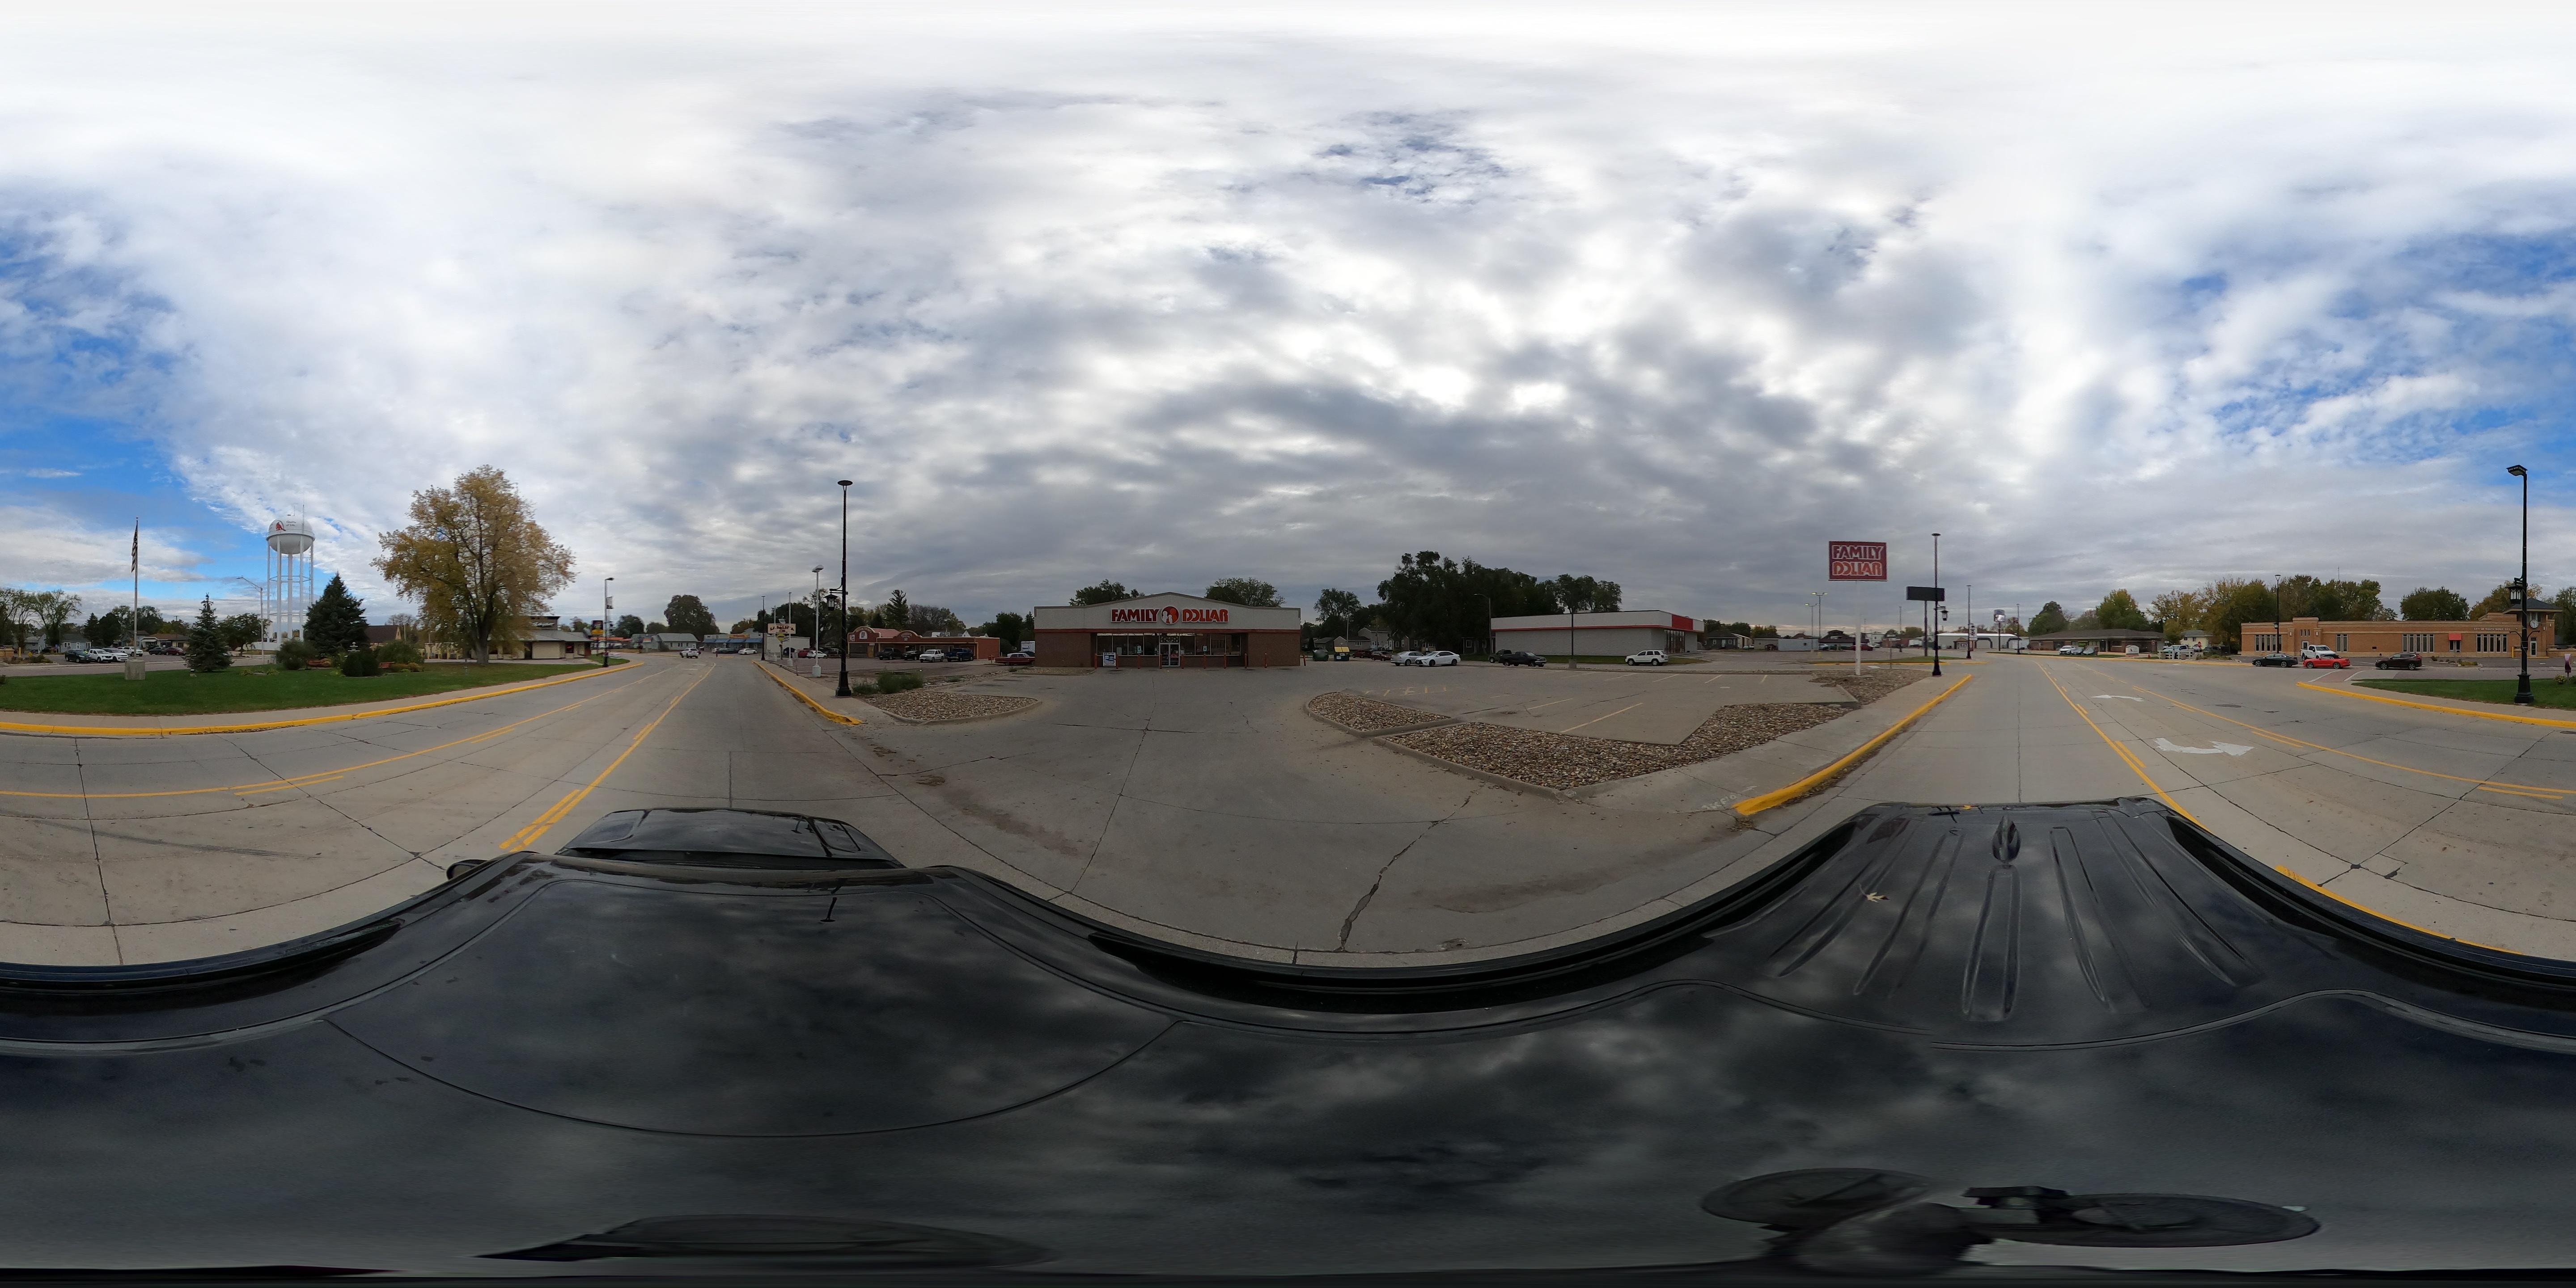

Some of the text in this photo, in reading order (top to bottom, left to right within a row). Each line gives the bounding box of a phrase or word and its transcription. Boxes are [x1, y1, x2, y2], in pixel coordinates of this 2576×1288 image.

[1833, 545, 1883, 559] FAMILY
[1832, 561, 1882, 576] DOLLAR
[1111, 609, 1229, 622] FAMILY DOLLAR
